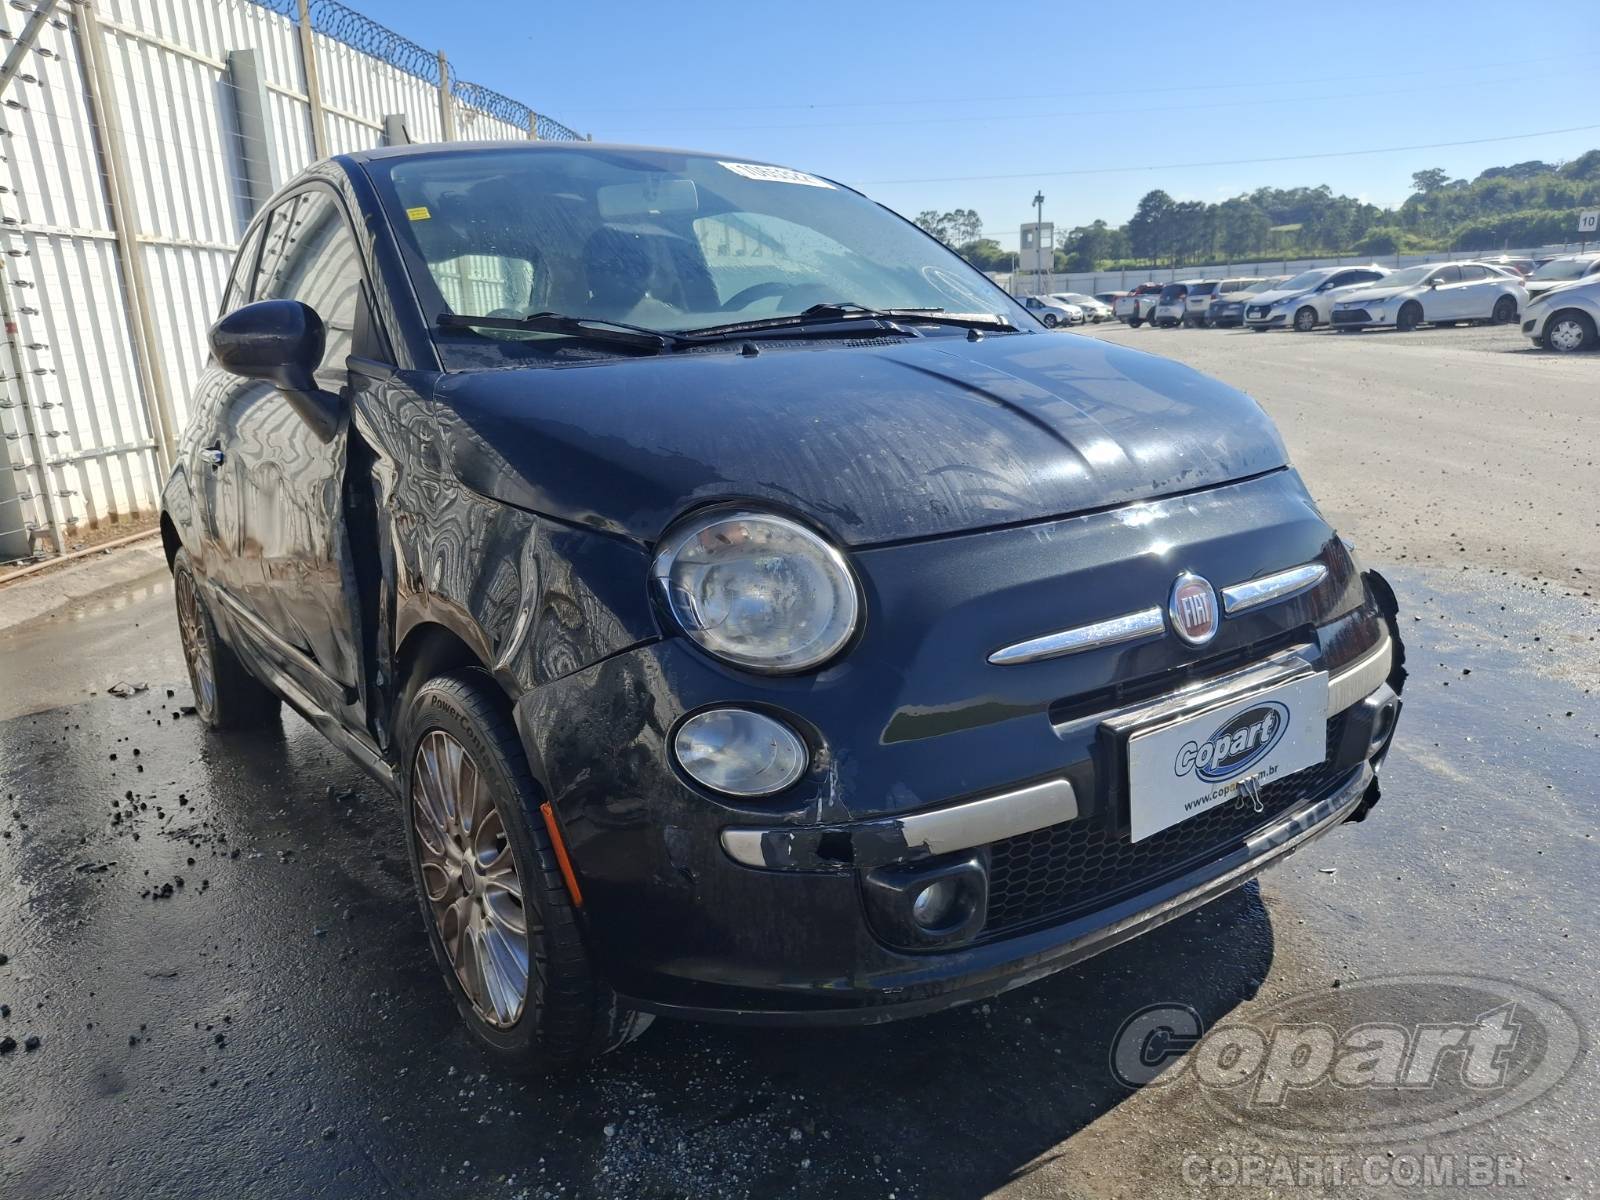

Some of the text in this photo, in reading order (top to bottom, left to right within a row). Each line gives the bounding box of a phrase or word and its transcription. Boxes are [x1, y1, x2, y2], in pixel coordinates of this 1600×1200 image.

[1582, 216, 1595, 226] 10
[1181, 592, 1210, 628] FIAT
[1174, 709, 1276, 777] Copart
